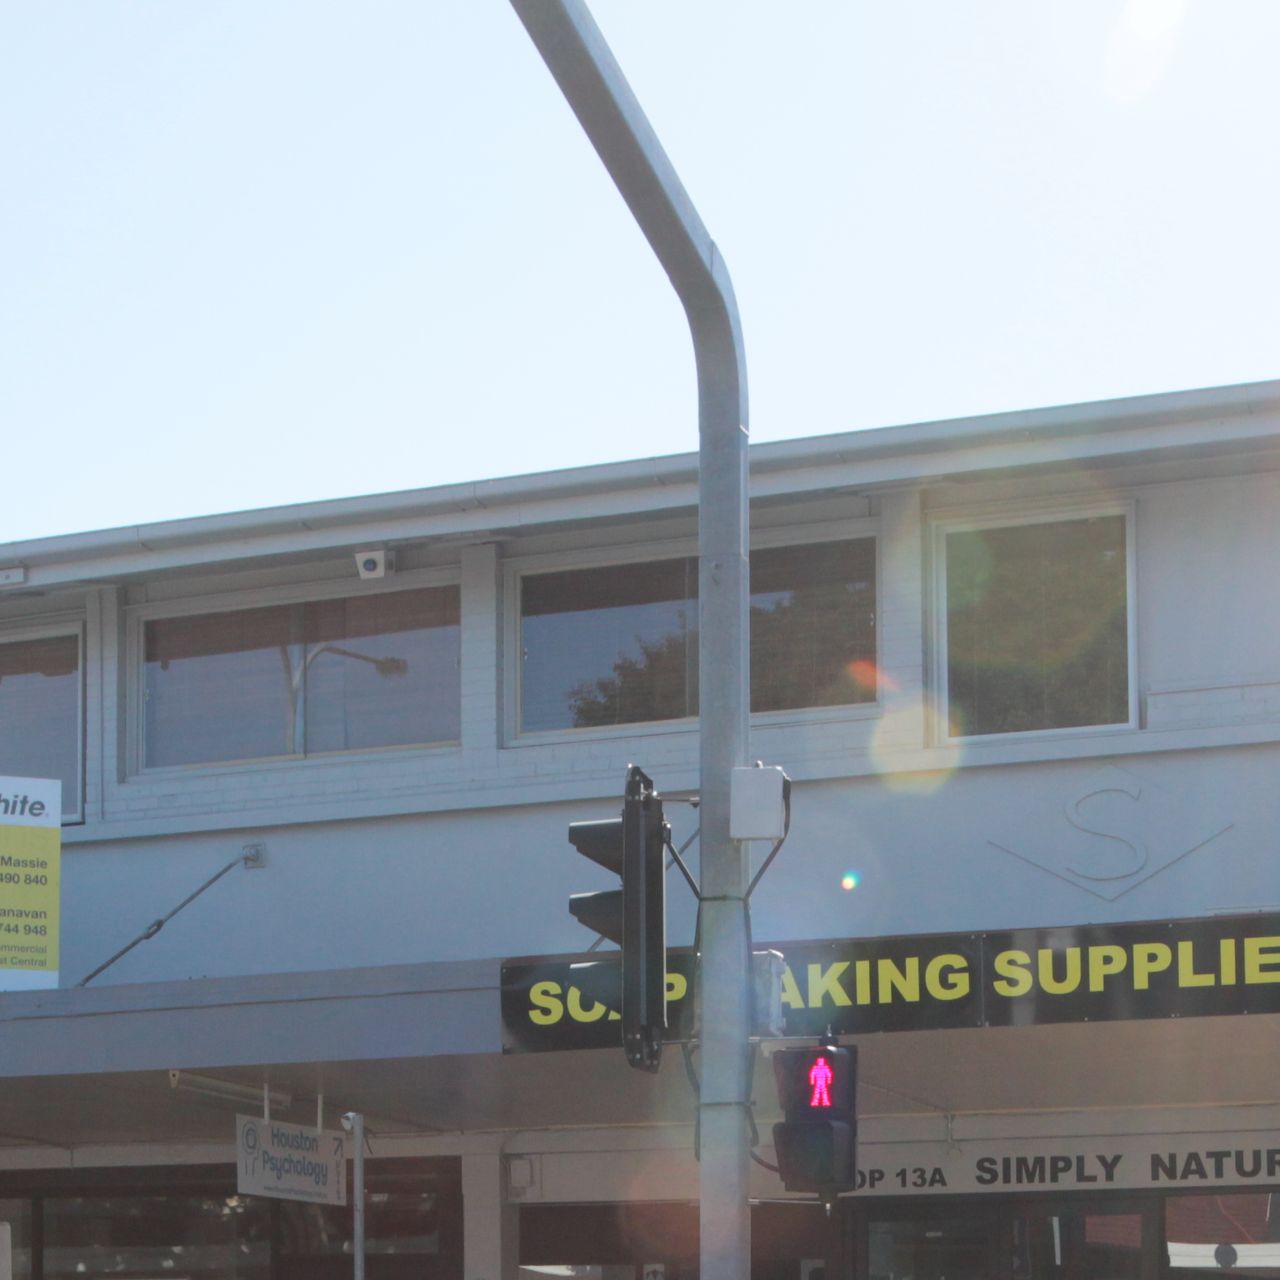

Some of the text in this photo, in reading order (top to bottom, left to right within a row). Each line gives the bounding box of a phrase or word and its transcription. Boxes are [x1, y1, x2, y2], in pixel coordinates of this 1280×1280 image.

[0, 855, 49, 870] Massie
[23, 875, 48, 887] 840
[23, 925, 48, 937] 948
[10, 957, 48, 968] Central
[780, 953, 970, 1010] AKING
[272, 1127, 319, 1153] Houston
[262, 1151, 328, 1186] Psychology
[895, 1167, 948, 1188] 13A
[975, 1154, 1124, 1185] SIMPLY
